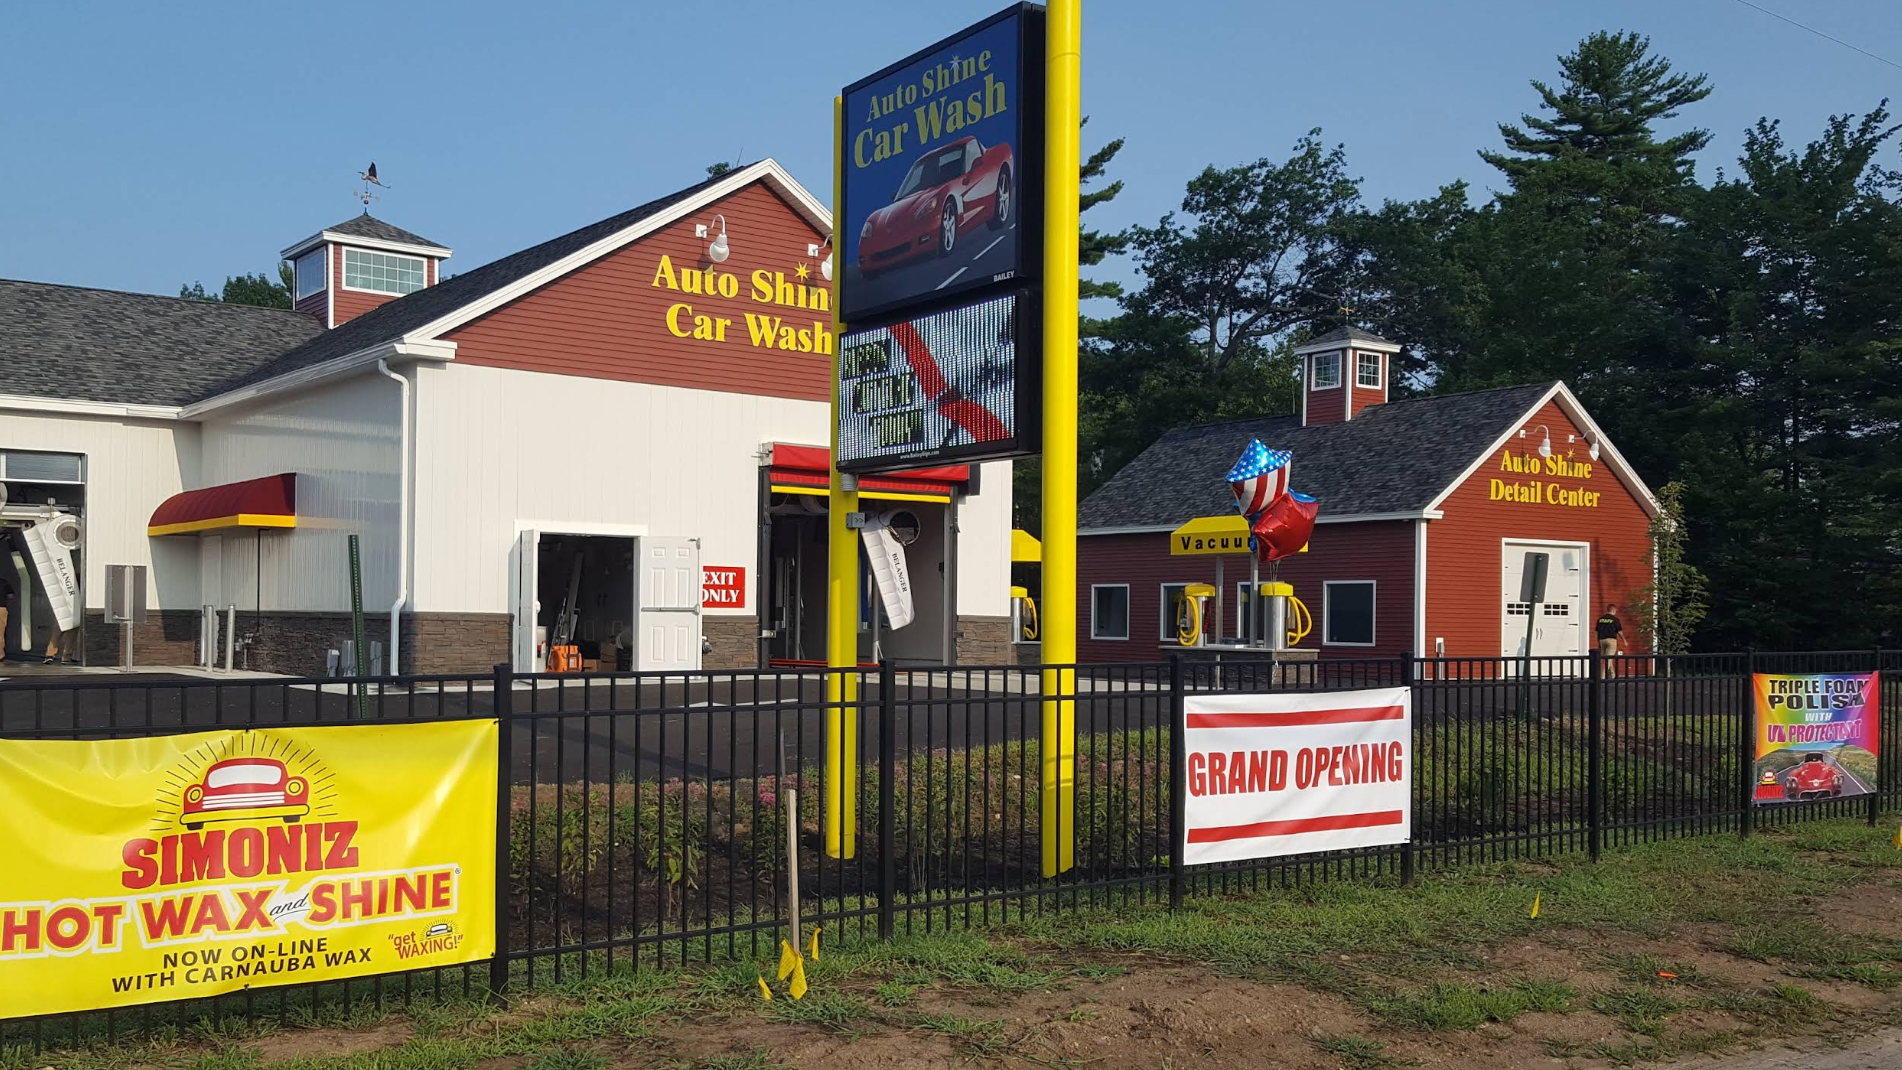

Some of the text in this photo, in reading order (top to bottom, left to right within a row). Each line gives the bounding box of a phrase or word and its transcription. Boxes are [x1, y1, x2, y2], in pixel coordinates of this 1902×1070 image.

[866, 49, 991, 123] Auto Shine
[854, 73, 1007, 169] Car Wash
[652, 254, 833, 312] Auto Shin
[993, 270, 1015, 282] BAILEY
[666, 303, 833, 355] Car Wash
[1500, 448, 1592, 479] Auto Shine
[1490, 478, 1600, 508] Detail Center
[56, 557, 75, 597] BELANGER
[702, 571, 737, 585] EXIT
[892, 552, 908, 593] BELANGER
[1769, 679, 1820, 694] TRIPLE
[1804, 712, 1833, 722] WITH
[1188, 741, 1403, 797] GRAND OPENING
[121, 820, 359, 890] SIMONIZ
[2, 871, 451, 952] HOT WAX and SHINE
[112, 947, 372, 993] WITH CARNAUBA WAX
[163, 937, 328, 970] NOW ON-LINE
